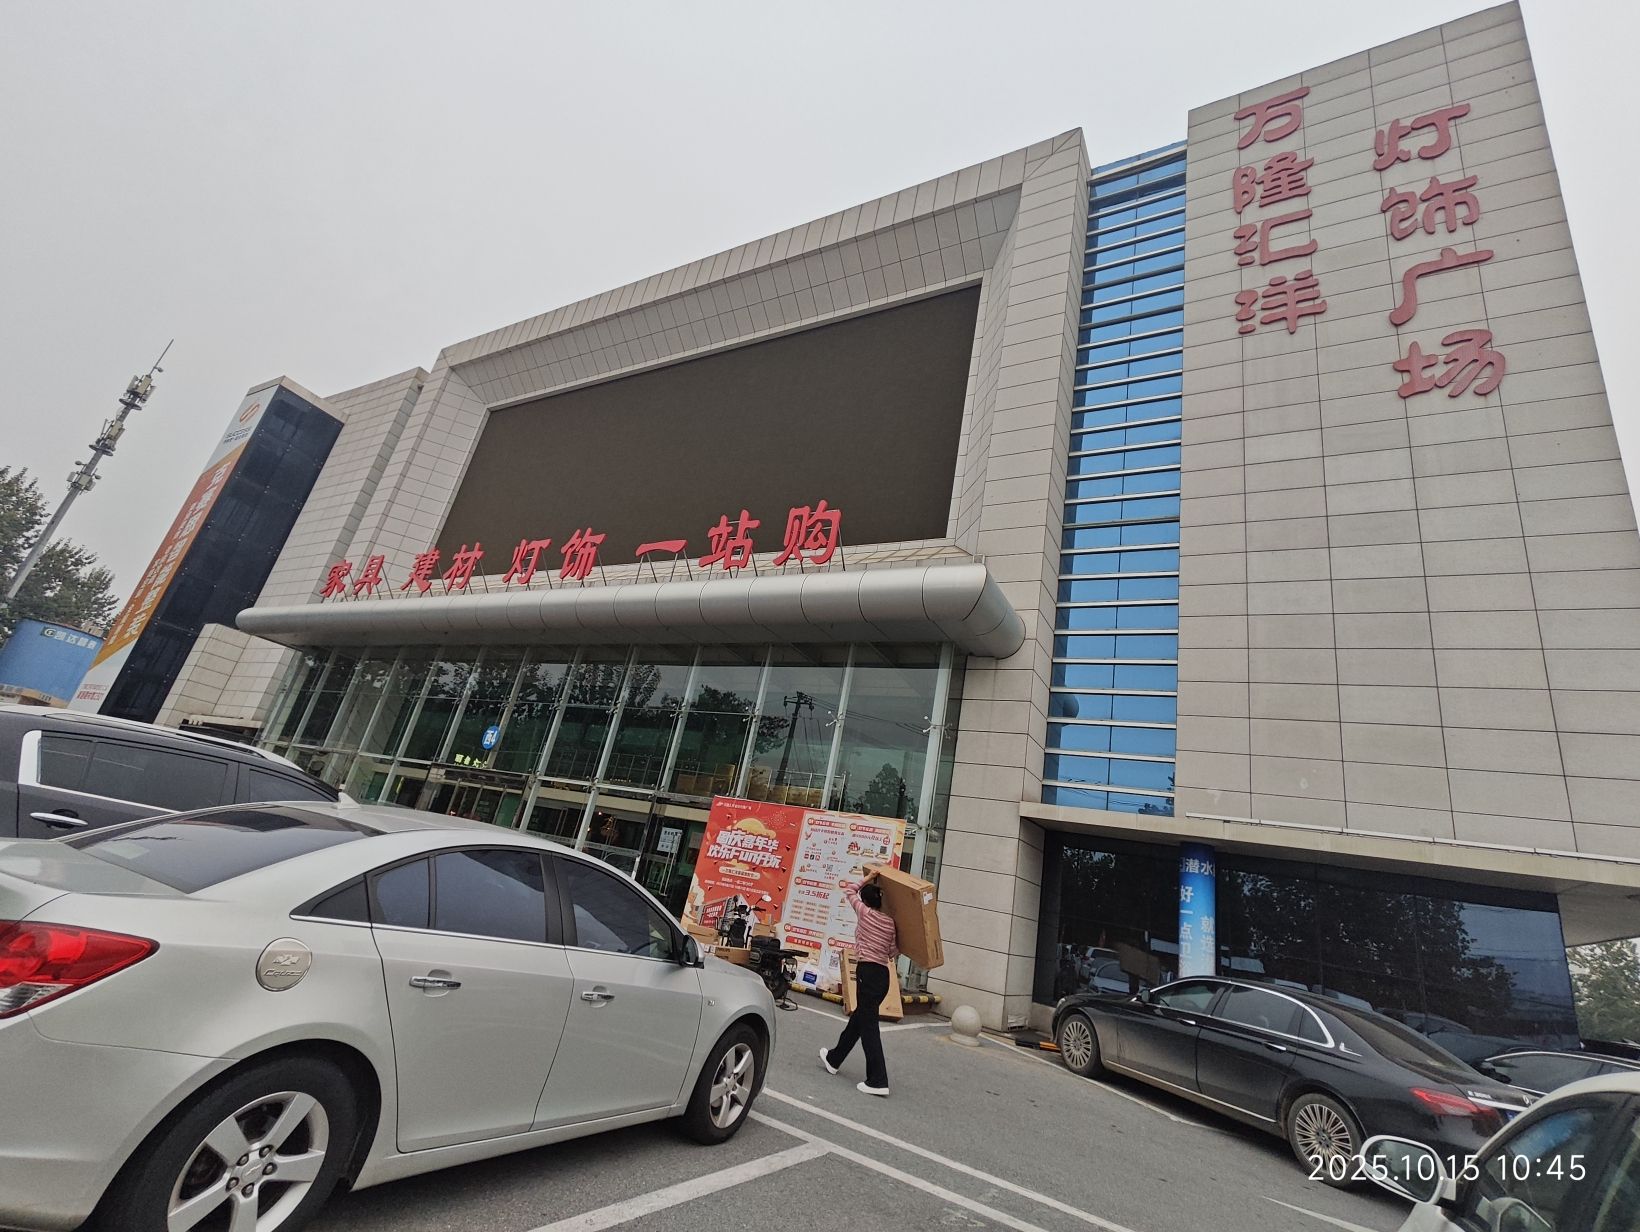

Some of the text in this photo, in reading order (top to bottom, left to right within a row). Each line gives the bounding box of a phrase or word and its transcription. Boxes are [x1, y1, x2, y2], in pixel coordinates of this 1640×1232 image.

[1233, 85, 1327, 334] 万隆汇洋
[1373, 102, 1506, 398] 灯饰广场
[319, 499, 842, 598] 家具 建材 灯饰 一站购
[1180, 857, 1215, 877] 潜水
